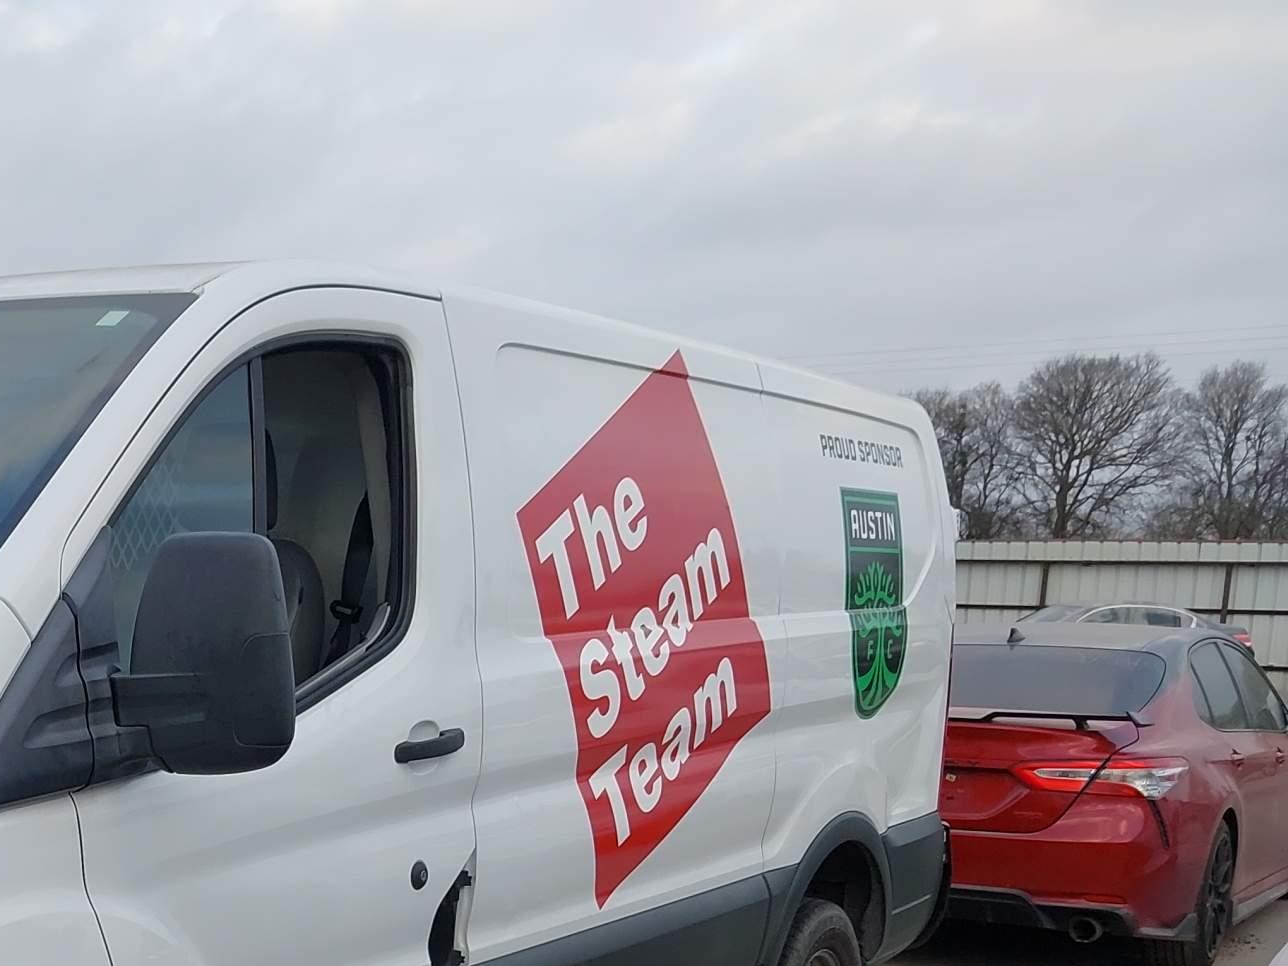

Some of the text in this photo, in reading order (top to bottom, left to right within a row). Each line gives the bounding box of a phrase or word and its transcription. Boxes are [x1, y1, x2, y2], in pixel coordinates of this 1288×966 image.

[819, 434, 903, 468] PROUD SPONSOR
[536, 476, 648, 619] The
[850, 509, 896, 541] AUSTIN
[579, 527, 731, 740] Steam
[588, 656, 737, 848] Team
